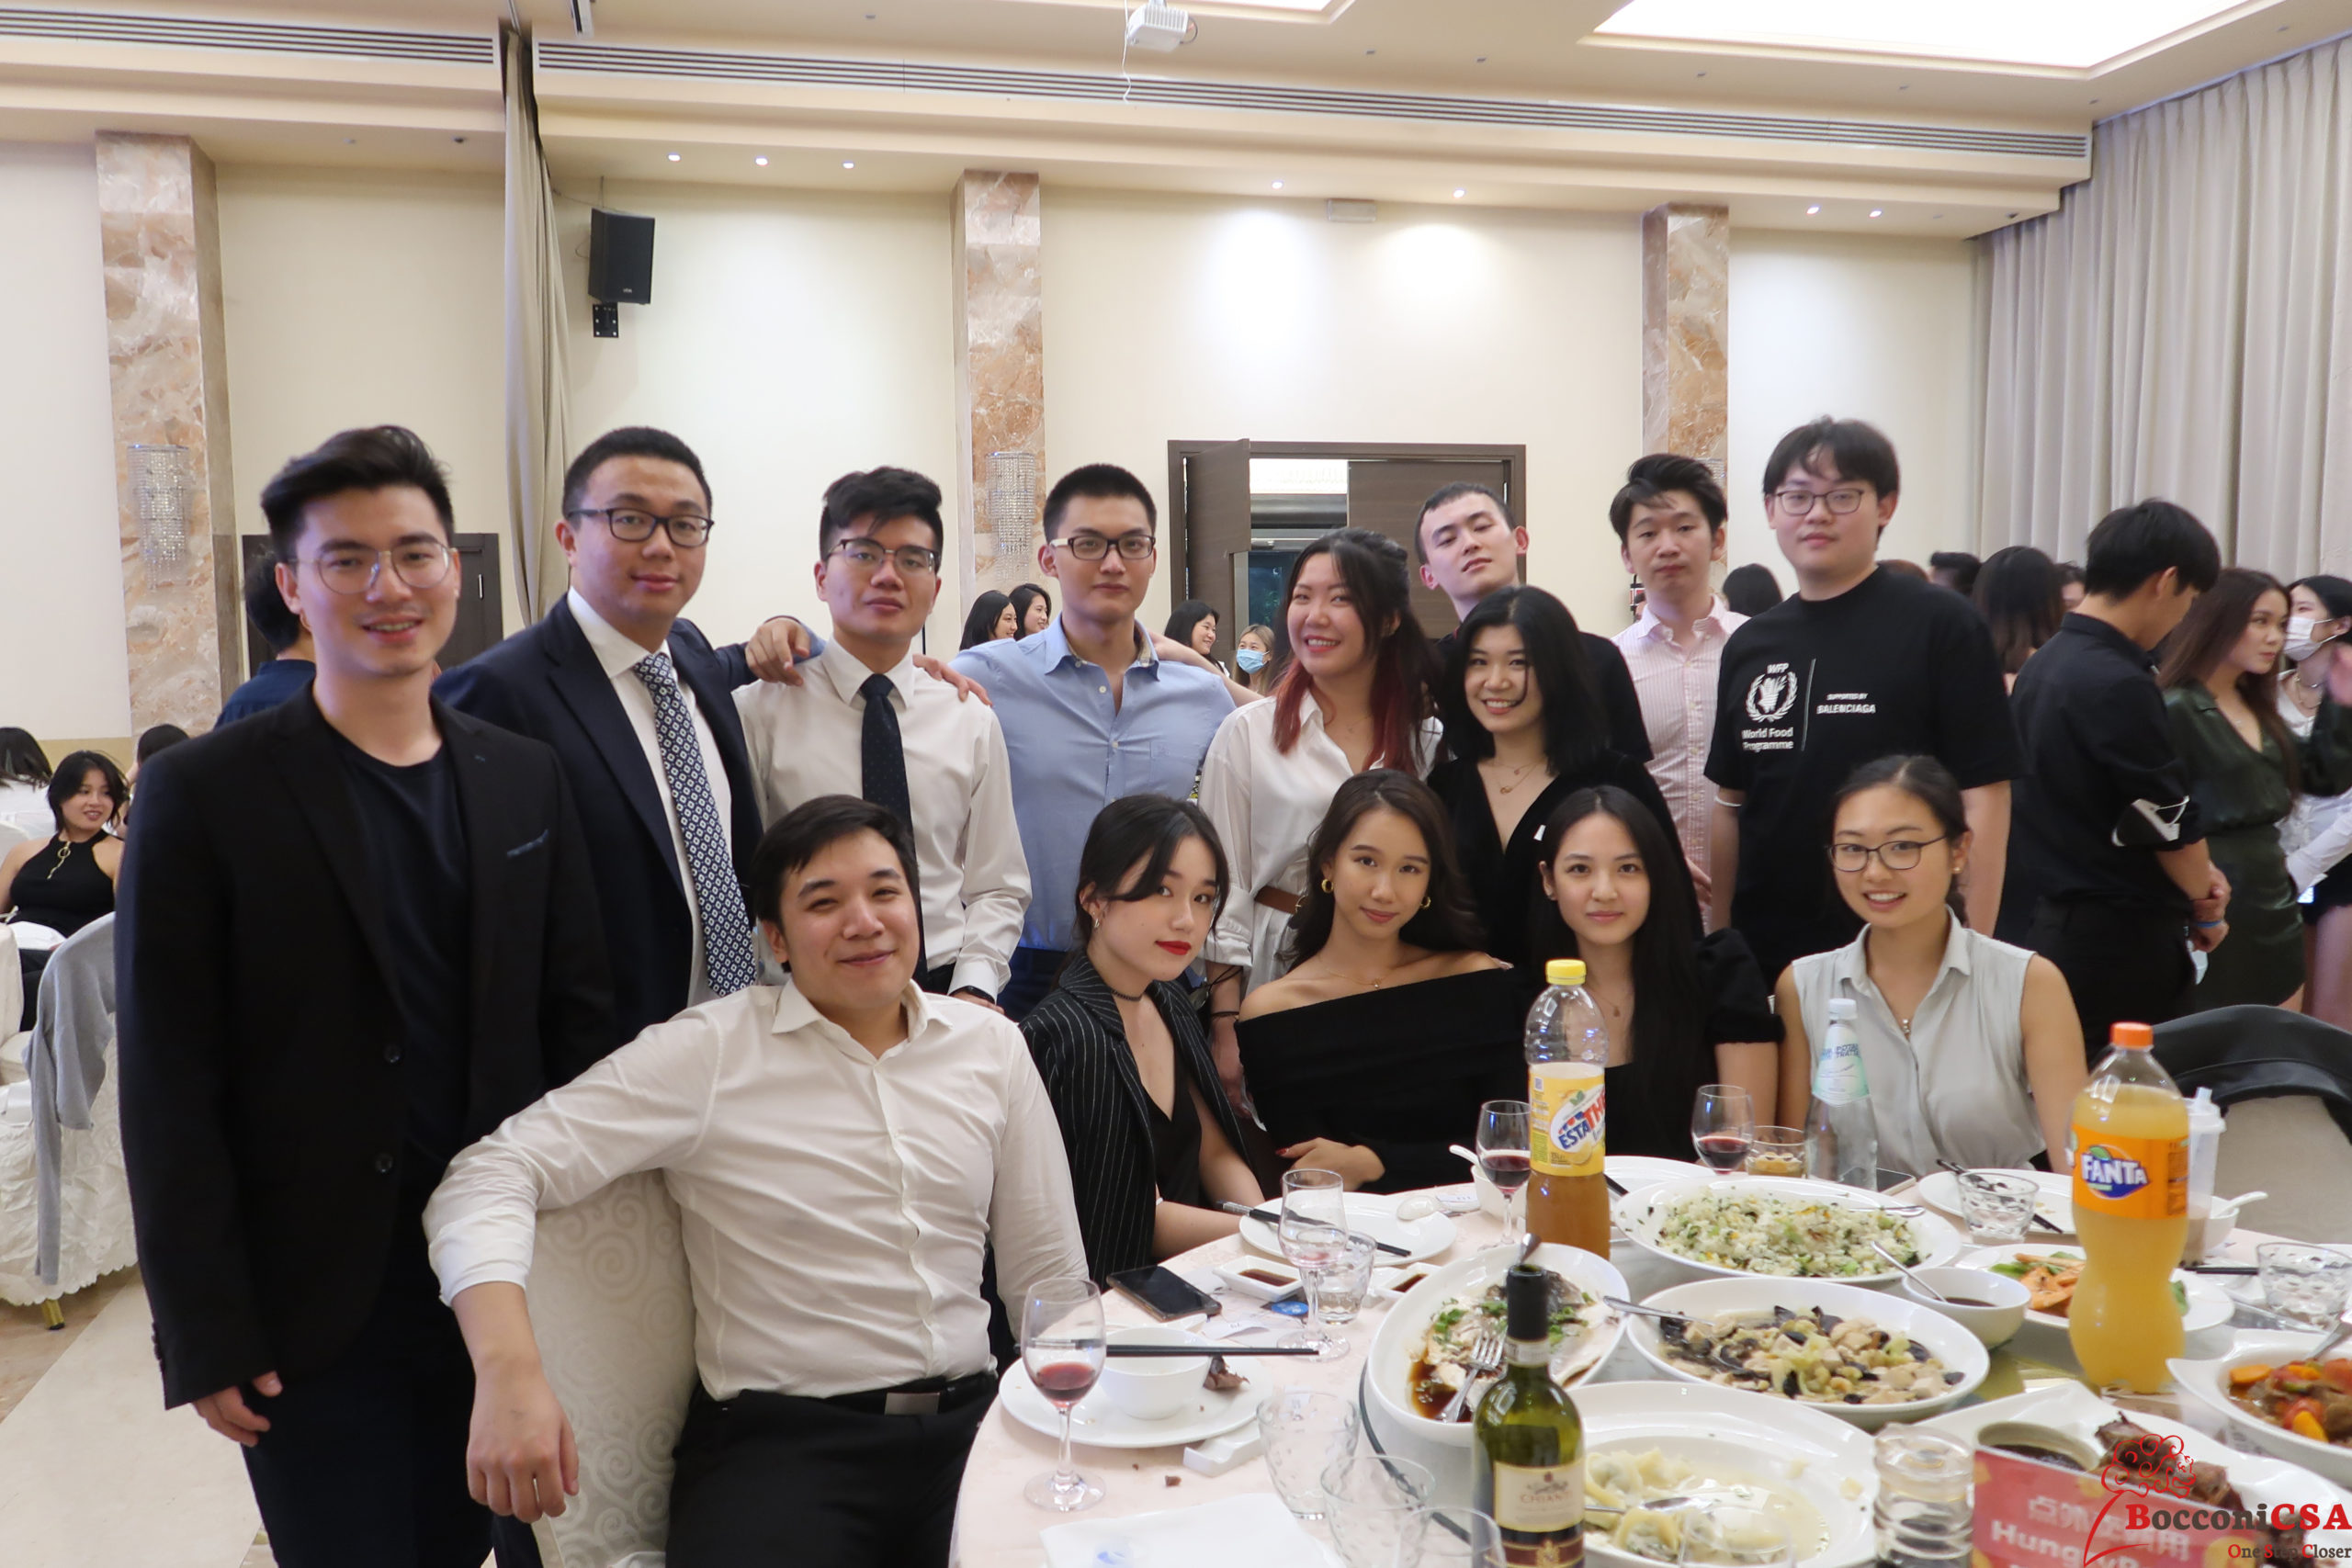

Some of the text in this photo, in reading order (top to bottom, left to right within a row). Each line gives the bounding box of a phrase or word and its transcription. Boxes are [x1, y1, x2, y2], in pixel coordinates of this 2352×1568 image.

[1767, 663, 1789, 673] WFP
[1816, 704, 1876, 715] BALENCIAGA
[1741, 727, 1793, 739] World Food
[1742, 741, 1793, 752] Programme
[2081, 1154, 2148, 1185] FANTA
